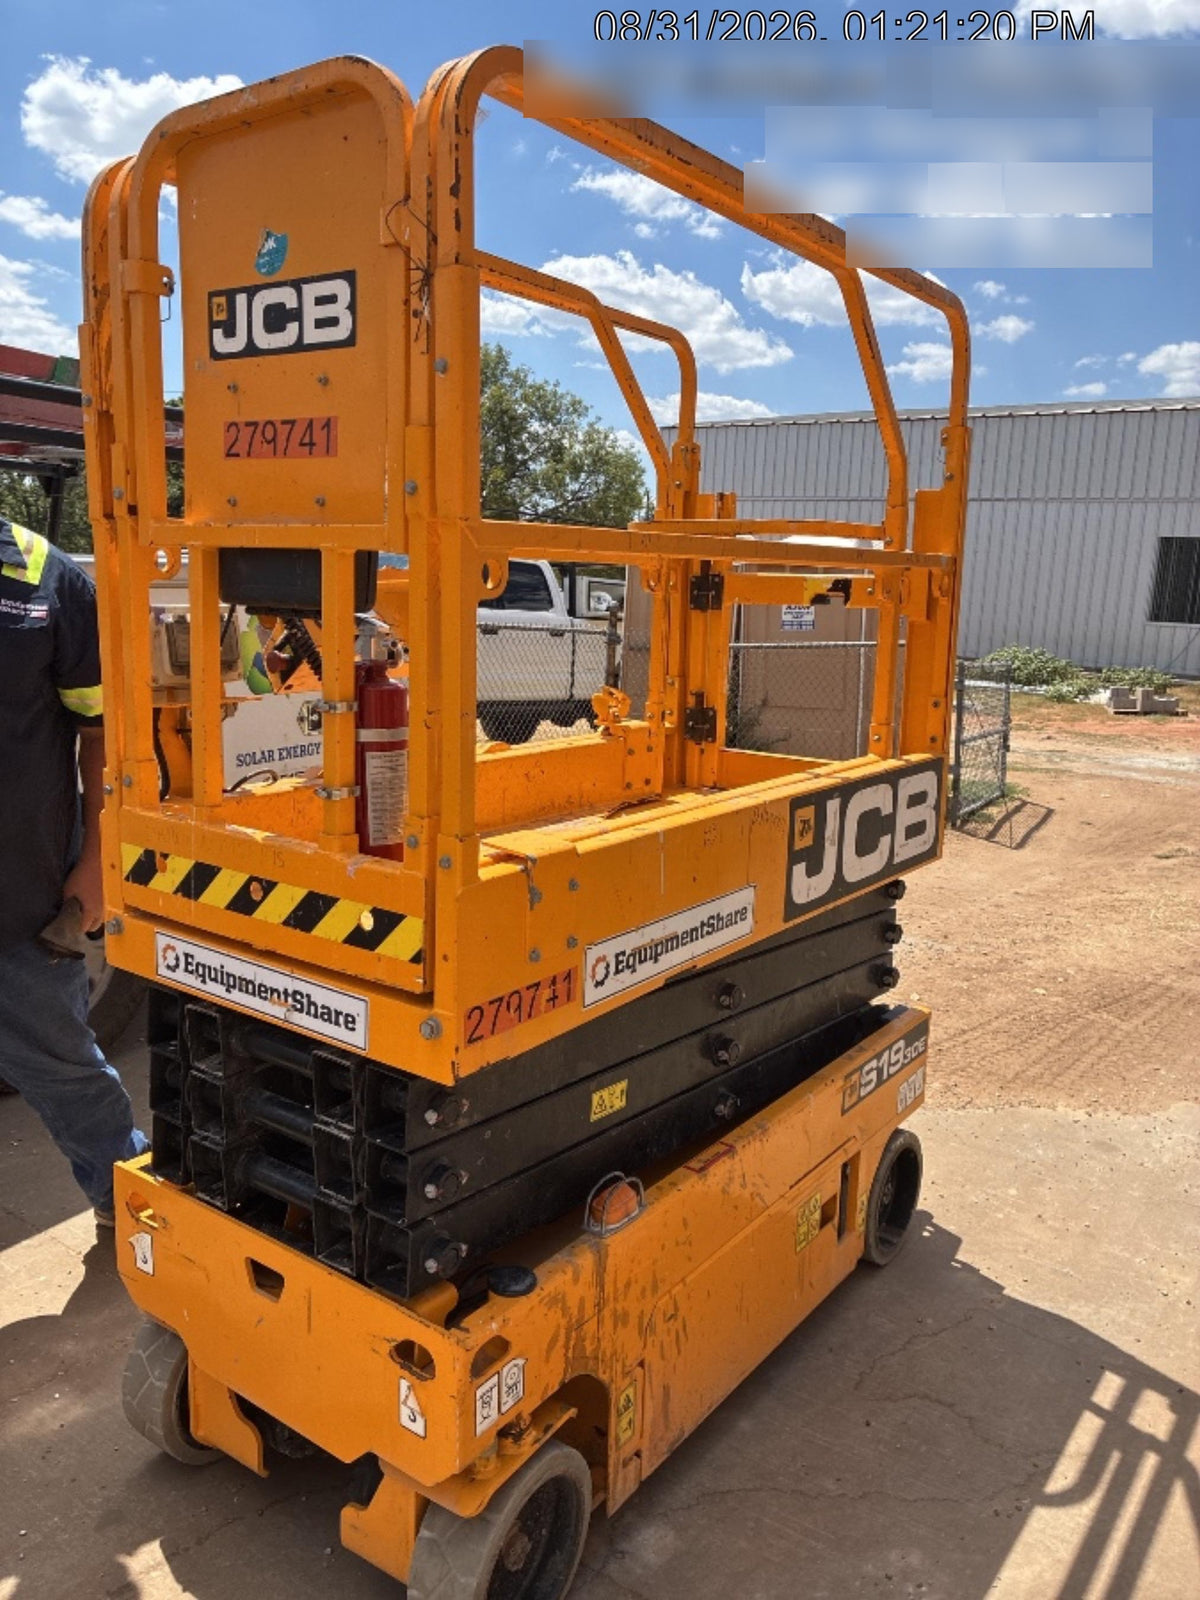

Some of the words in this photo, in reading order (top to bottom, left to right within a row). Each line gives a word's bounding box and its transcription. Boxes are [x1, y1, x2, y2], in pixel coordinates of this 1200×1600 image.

[212, 278, 353, 354] JCB
[225, 417, 332, 457] 279741
[236, 749, 275, 767] SOLAR
[277, 742, 322, 761] ENERGY
[791, 771, 938, 904] JCB
[613, 906, 748, 977] EquipmentShare
[183, 952, 357, 1031] EquipmentShare
